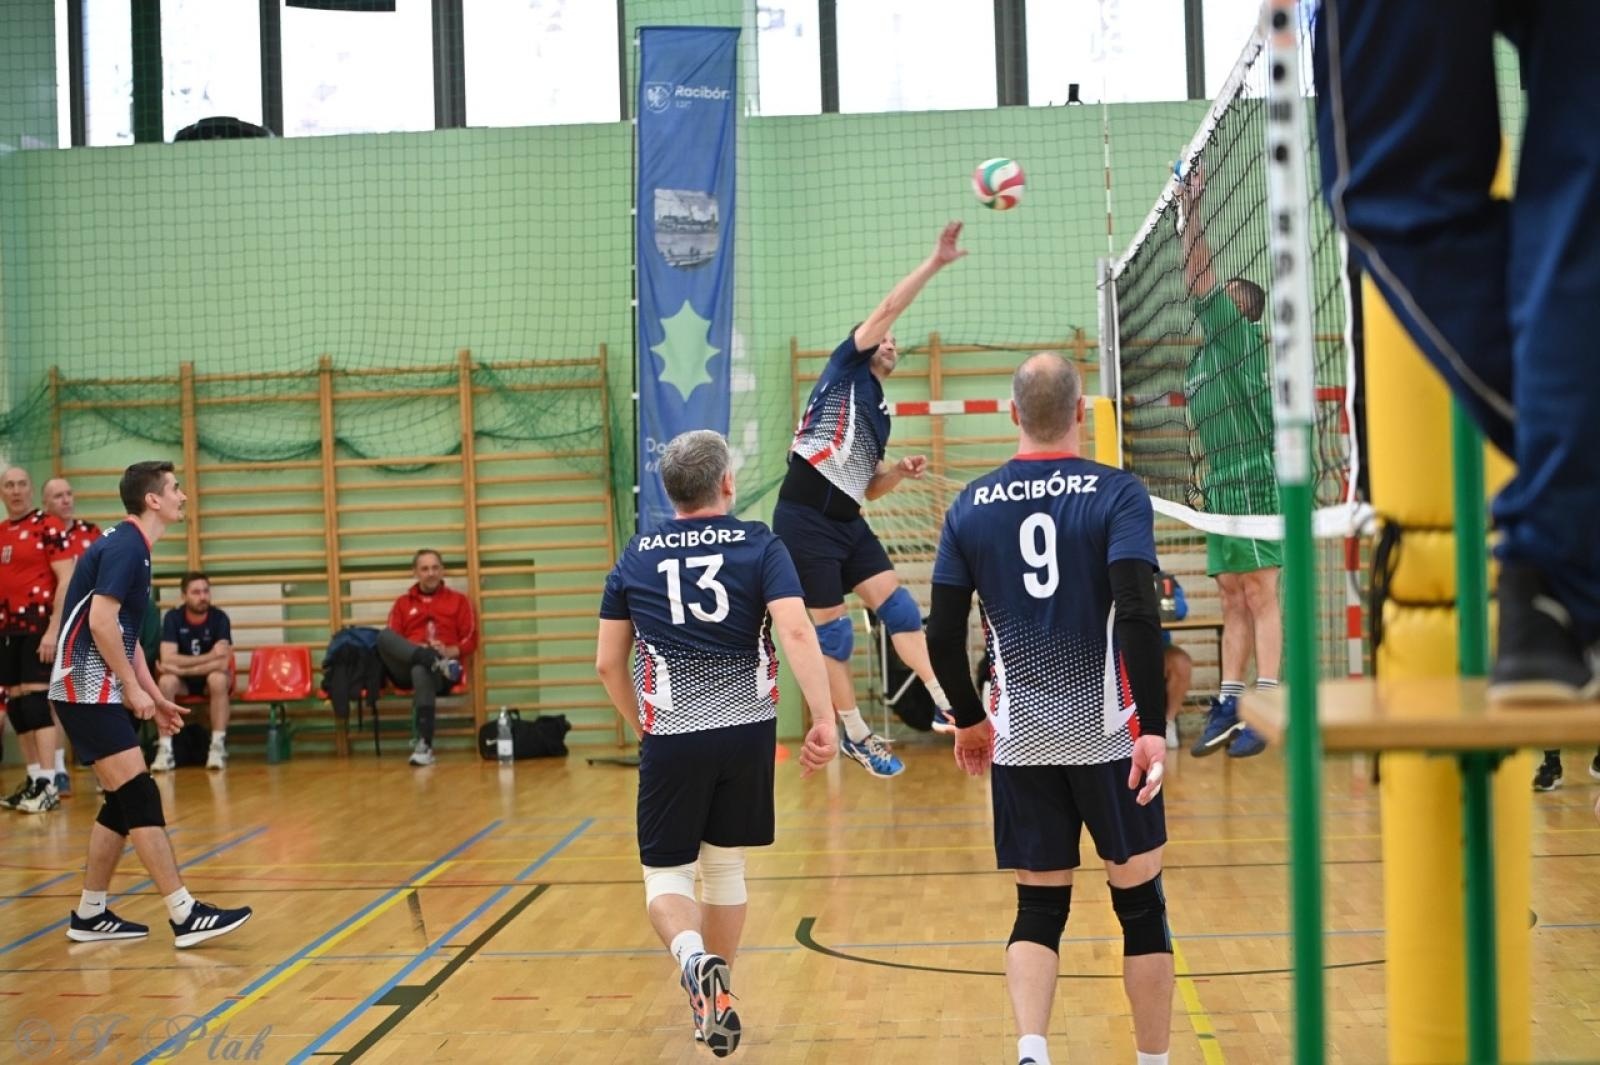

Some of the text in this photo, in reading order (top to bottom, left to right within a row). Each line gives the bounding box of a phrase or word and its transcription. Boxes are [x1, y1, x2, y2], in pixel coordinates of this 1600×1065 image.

[674, 85, 731, 100] Racibór
[973, 469, 1099, 506] RACIBÓRZ
[638, 525, 746, 552] RACIBÓRZ
[1019, 512, 1060, 599] 9
[657, 553, 730, 625] 13
